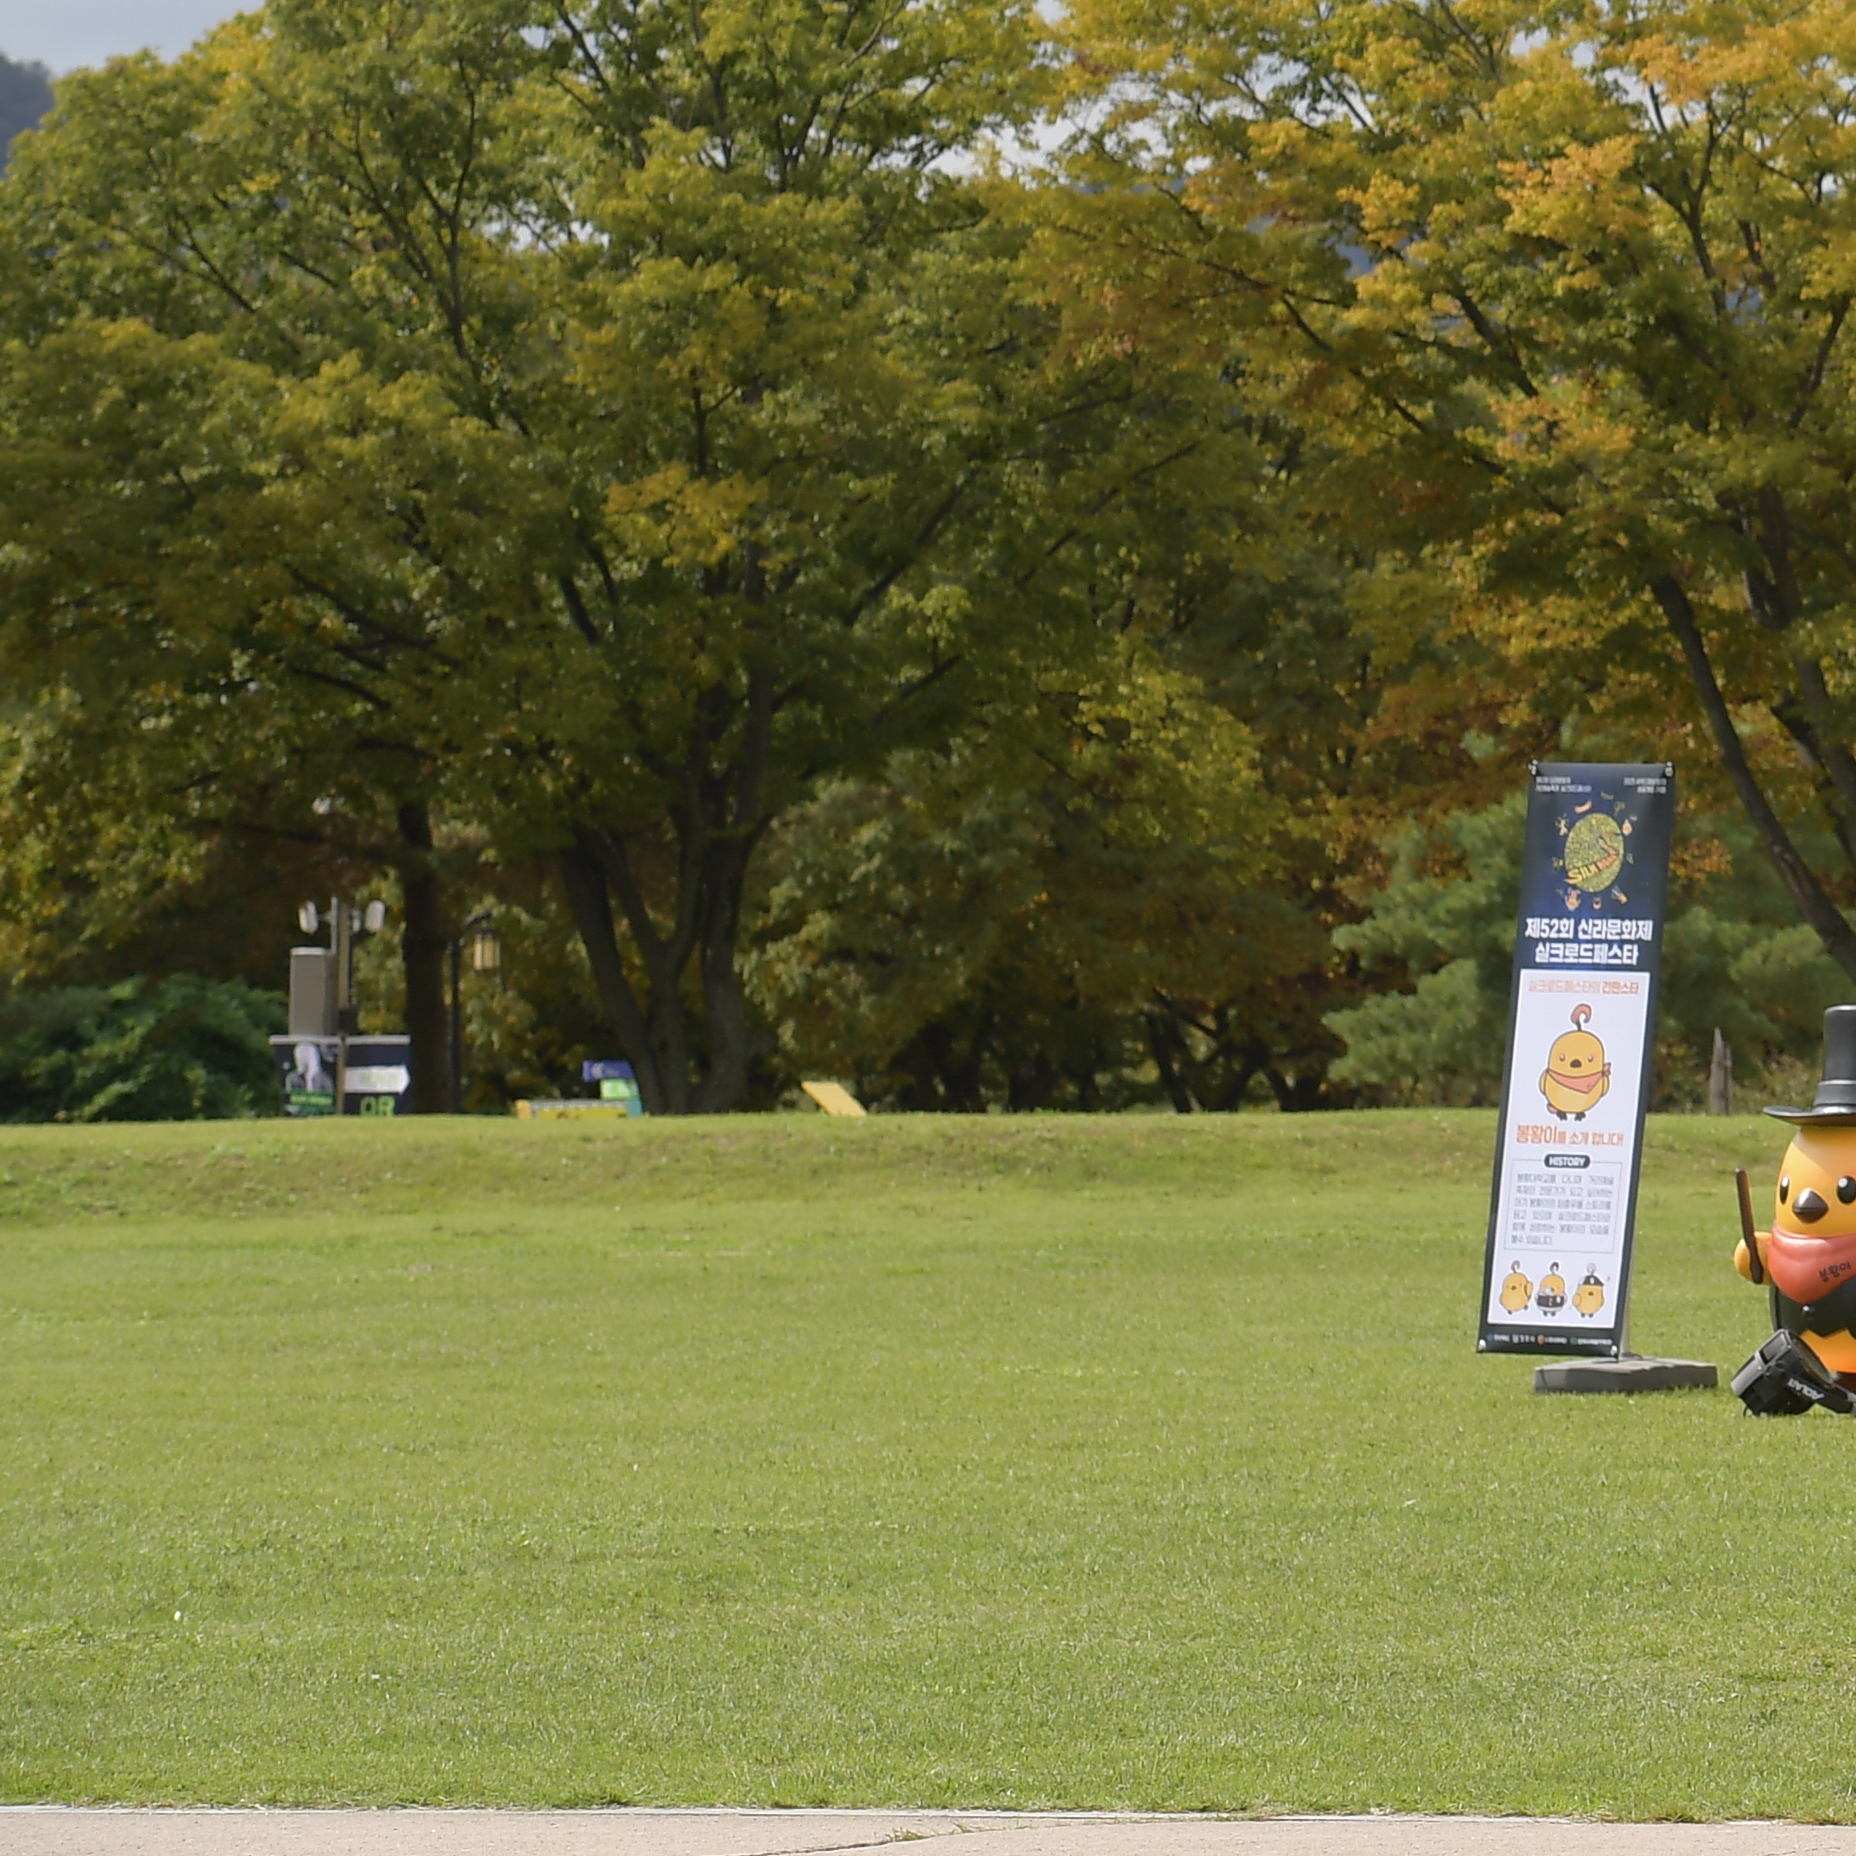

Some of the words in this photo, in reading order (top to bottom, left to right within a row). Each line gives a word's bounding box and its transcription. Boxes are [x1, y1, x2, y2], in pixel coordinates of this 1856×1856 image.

[1525, 917, 1575, 939] 제52회
[1578, 918, 1653, 941] 신라문화제
[1535, 942, 1639, 965] 실크로드페스타
[1549, 1157, 1586, 1166] HISTORY
